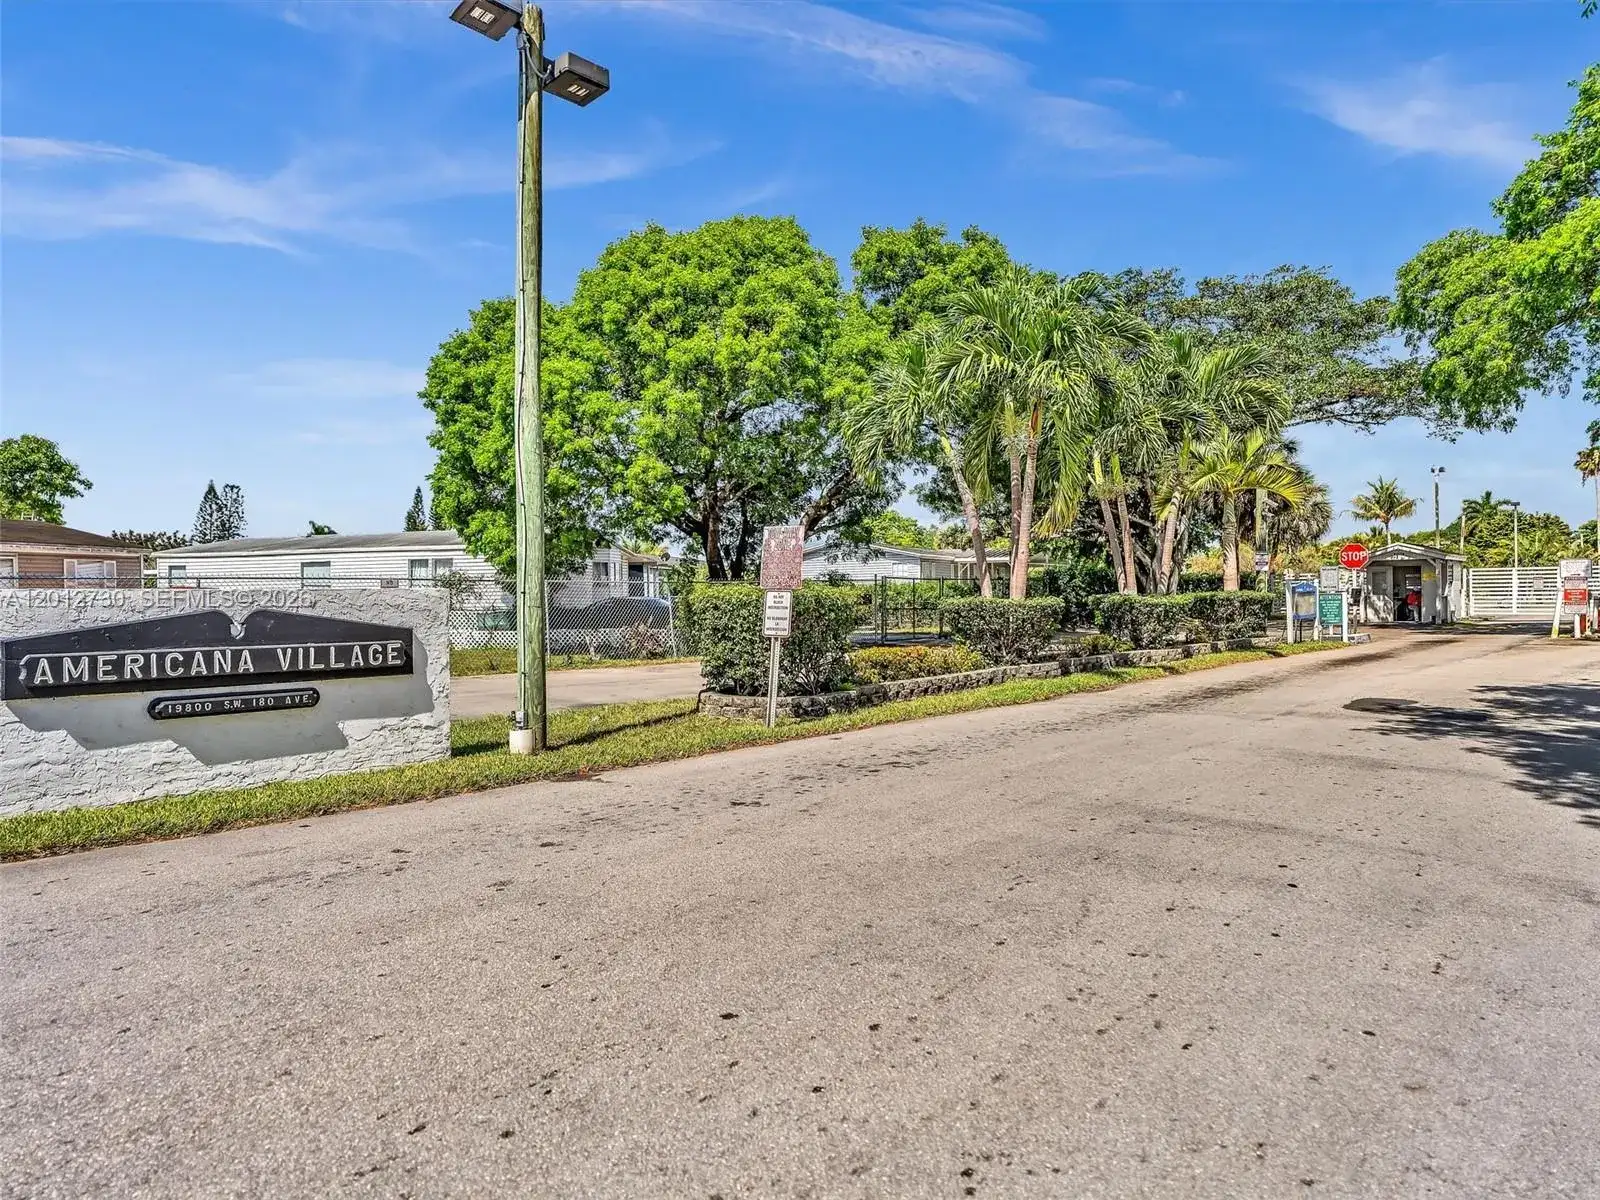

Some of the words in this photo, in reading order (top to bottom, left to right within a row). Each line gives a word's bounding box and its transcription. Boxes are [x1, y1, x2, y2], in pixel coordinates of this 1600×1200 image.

[1341, 551, 1367, 562] STOP
[34, 648, 255, 685] AMERICANA
[276, 643, 402, 671] VILLAGE
[168, 702, 212, 714] 19800
[223, 700, 246, 709] S.W.
[252, 697, 275, 707] 180
[285, 694, 313, 705] AVE.
